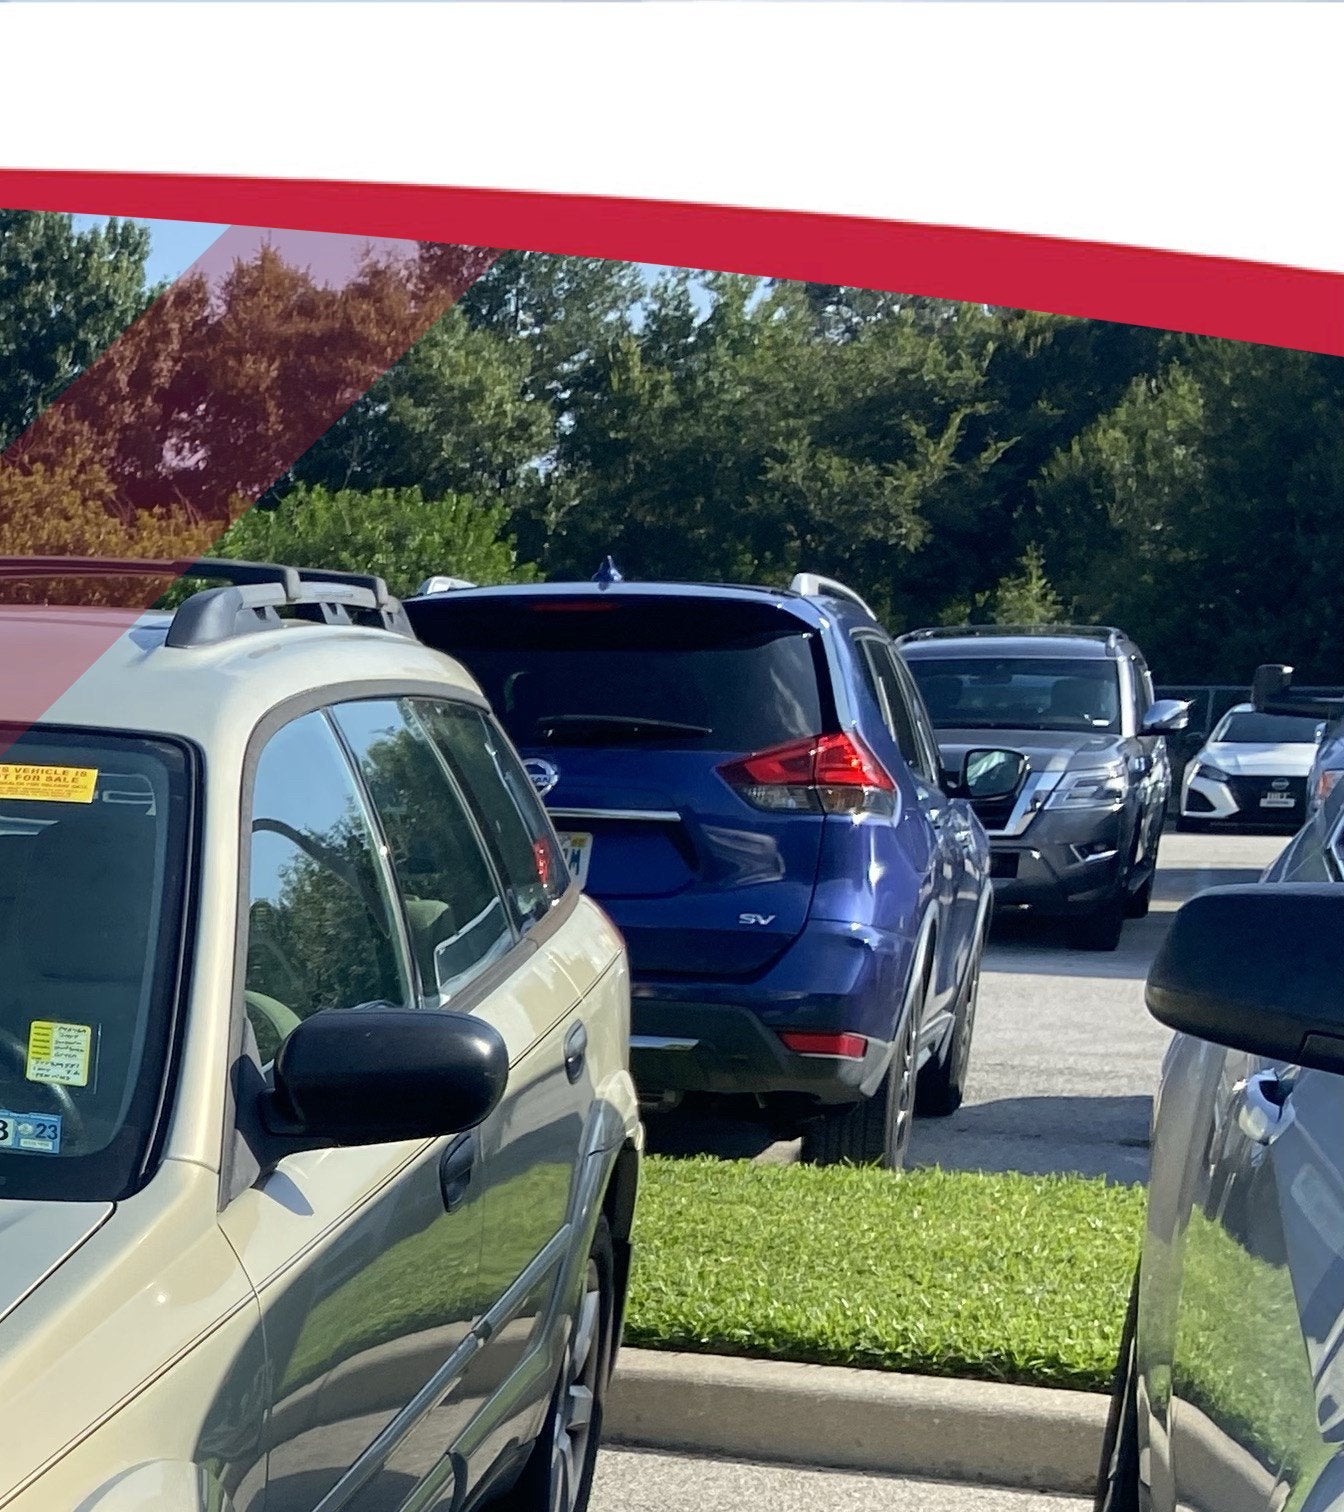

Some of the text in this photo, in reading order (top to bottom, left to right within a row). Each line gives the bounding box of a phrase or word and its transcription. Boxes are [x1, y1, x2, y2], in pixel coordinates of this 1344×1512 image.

[14, 767, 70, 776] VEHICLE
[75, 770, 88, 778] IS
[45, 776, 80, 784] SALE
[739, 913, 775, 925] SV
[35, 1123, 58, 1140] 23
